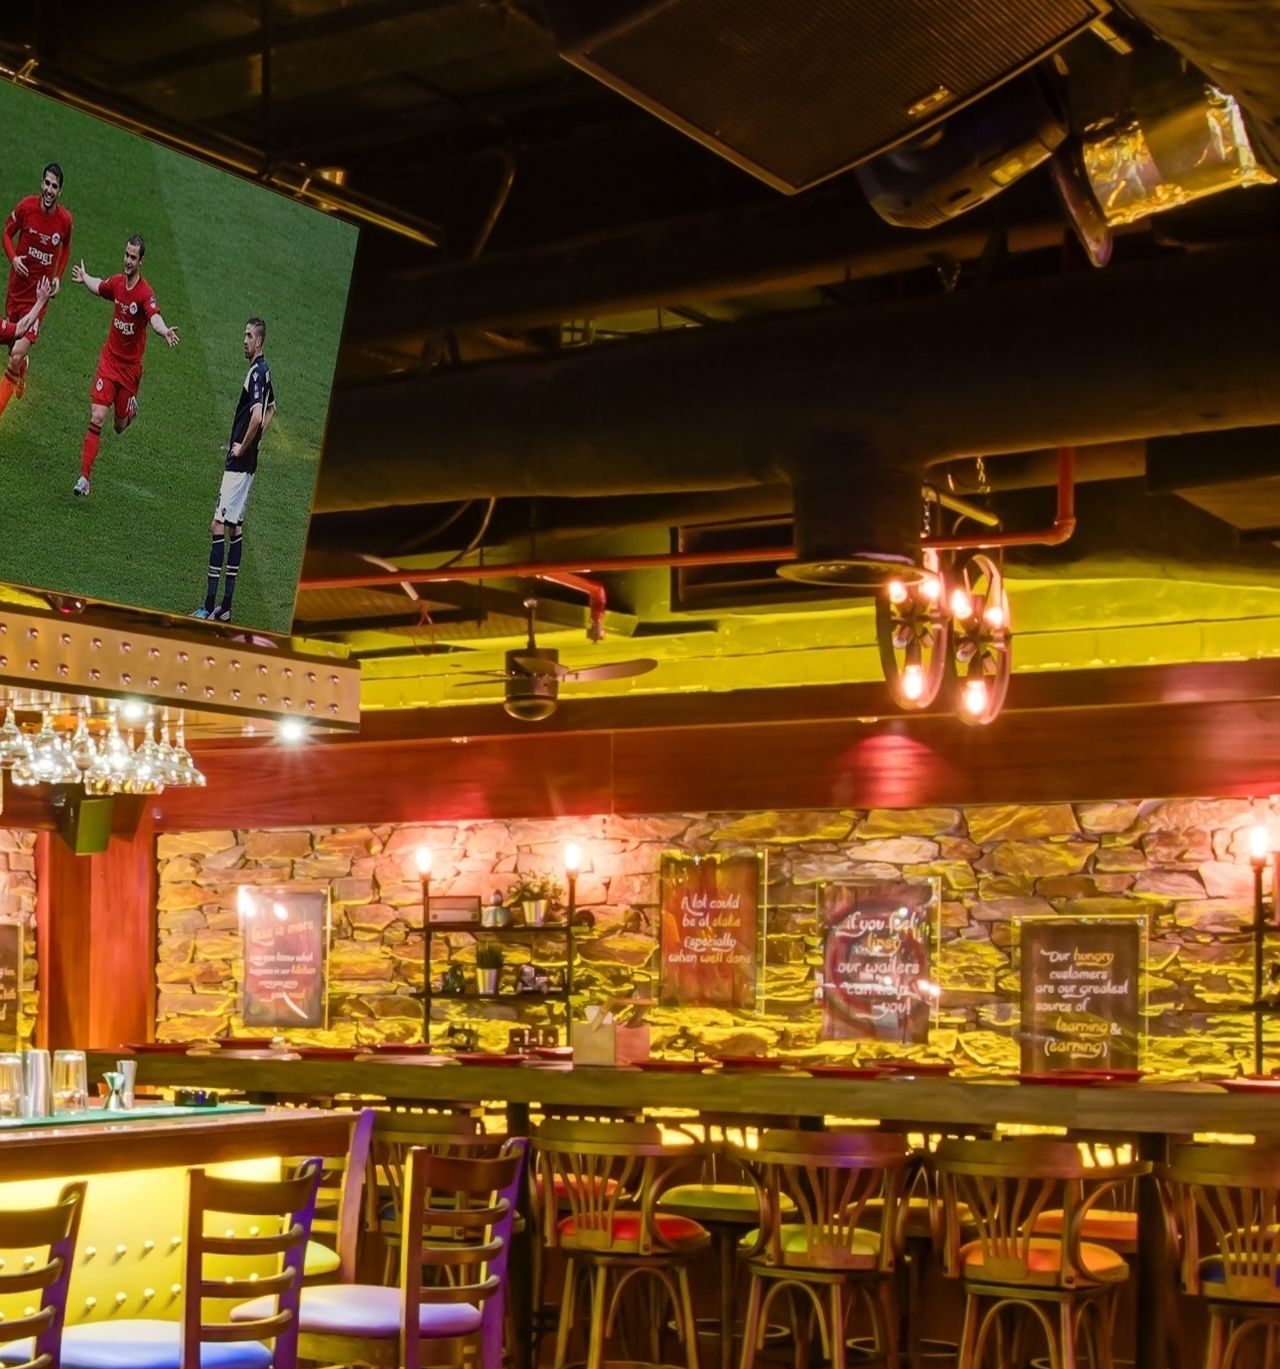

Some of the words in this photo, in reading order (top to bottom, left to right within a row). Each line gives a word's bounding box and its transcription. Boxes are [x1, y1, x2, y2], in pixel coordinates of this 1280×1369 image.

[692, 893, 708, 909] lot
[709, 893, 741, 909] could
[682, 913, 696, 927] be
[698, 912, 710, 927] at
[684, 932, 737, 952] Especially
[668, 948, 698, 963] when
[700, 950, 724, 963] well
[1040, 949, 1071, 963] Our
[1073, 947, 1115, 967] hungry
[836, 963, 862, 974] our
[864, 954, 920, 975] waiters
[1049, 965, 1109, 980] customers
[1035, 984, 1055, 994] are
[1057, 984, 1078, 994] our
[1061, 980, 1129, 999] greatest
[1035, 1003, 1072, 1013] source
[1075, 997, 1091, 1012] of
[1055, 1016, 1108, 1037] learning
[1110, 1023, 1123, 1035] &
[1043, 1039, 1108, 1059] (earning)
